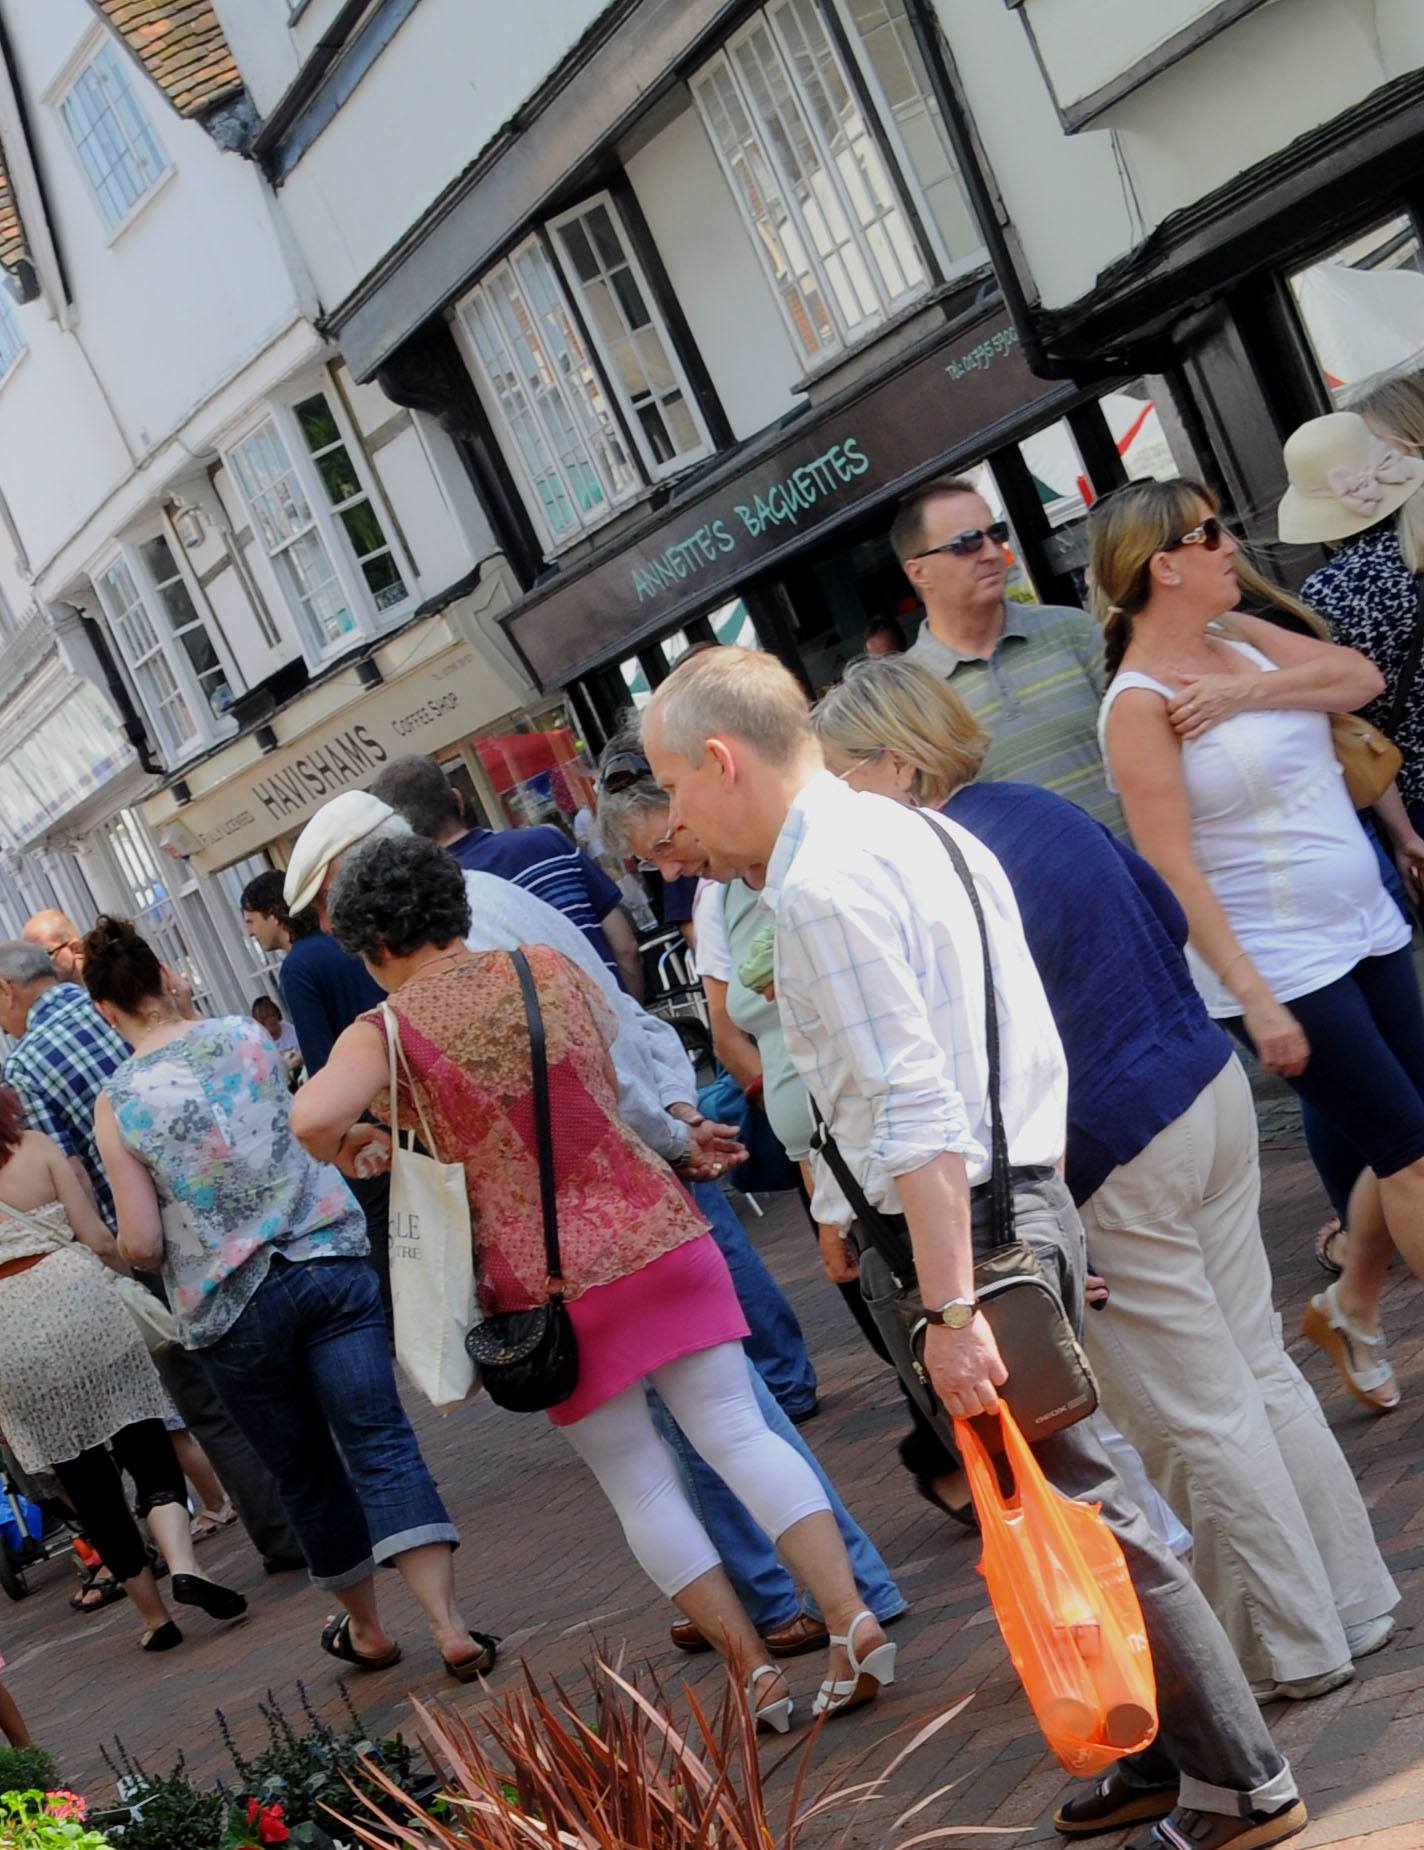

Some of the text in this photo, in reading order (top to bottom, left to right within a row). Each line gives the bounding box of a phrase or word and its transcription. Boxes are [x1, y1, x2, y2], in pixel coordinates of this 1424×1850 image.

[632, 438, 869, 602] ANNETTE'S BAGUETTES
[252, 692, 458, 820] HAVISHAMS COFFEE SHOP
